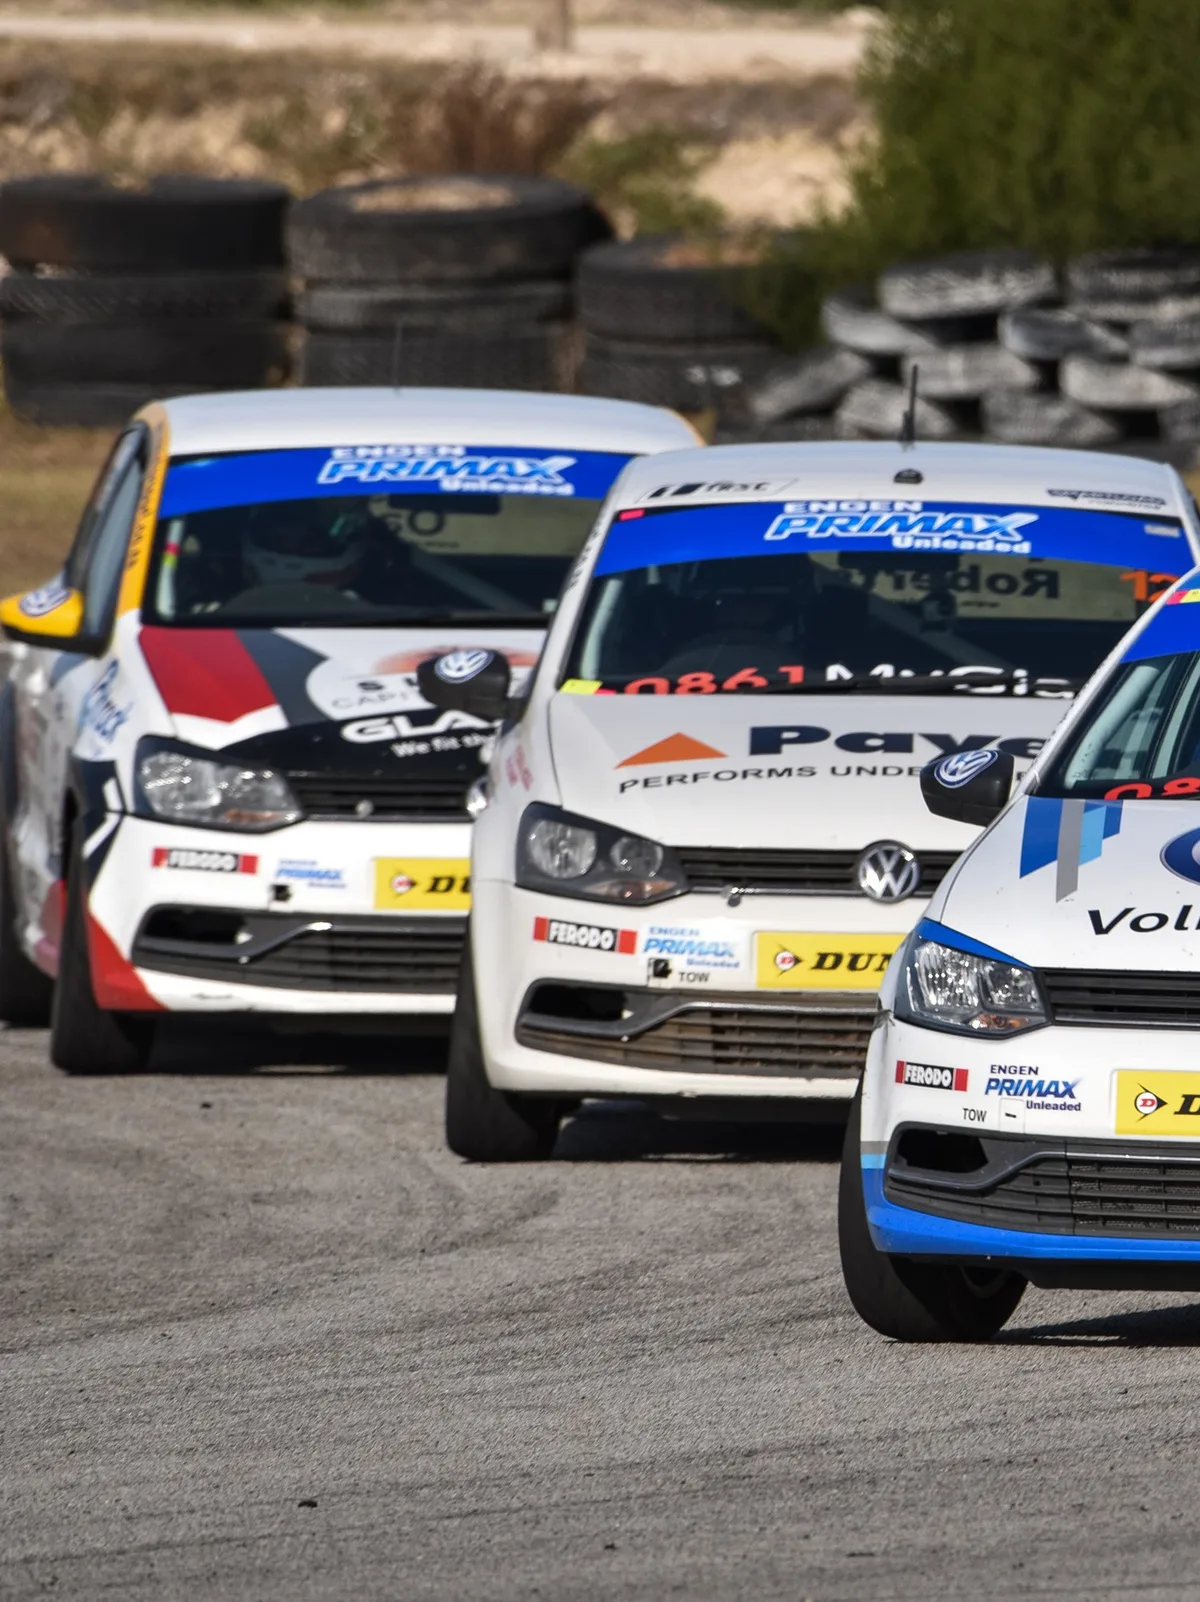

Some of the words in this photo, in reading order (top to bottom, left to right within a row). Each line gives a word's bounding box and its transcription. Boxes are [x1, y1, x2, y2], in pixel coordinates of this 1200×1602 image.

[317, 456, 577, 485] PRIMAX
[439, 478, 574, 496] Unleaded
[784, 501, 923, 514] ENGEN
[764, 512, 1039, 541] PRIMAX
[892, 536, 1031, 555] Unleaded
[624, 665, 804, 696] 0861
[340, 710, 504, 743] GLA
[619, 766, 817, 793] PERFORMS
[830, 766, 920, 778] UNDE
[549, 921, 614, 950] FERODO
[644, 937, 739, 958] PRIMAX
[679, 971, 710, 983] TOW
[904, 1061, 953, 1089] FERODO
[990, 1064, 1039, 1075] ENGEN
[984, 1077, 1084, 1099] PRIMAX
[962, 1107, 987, 1123] TOW
[1026, 1100, 1082, 1112] Unleaded
